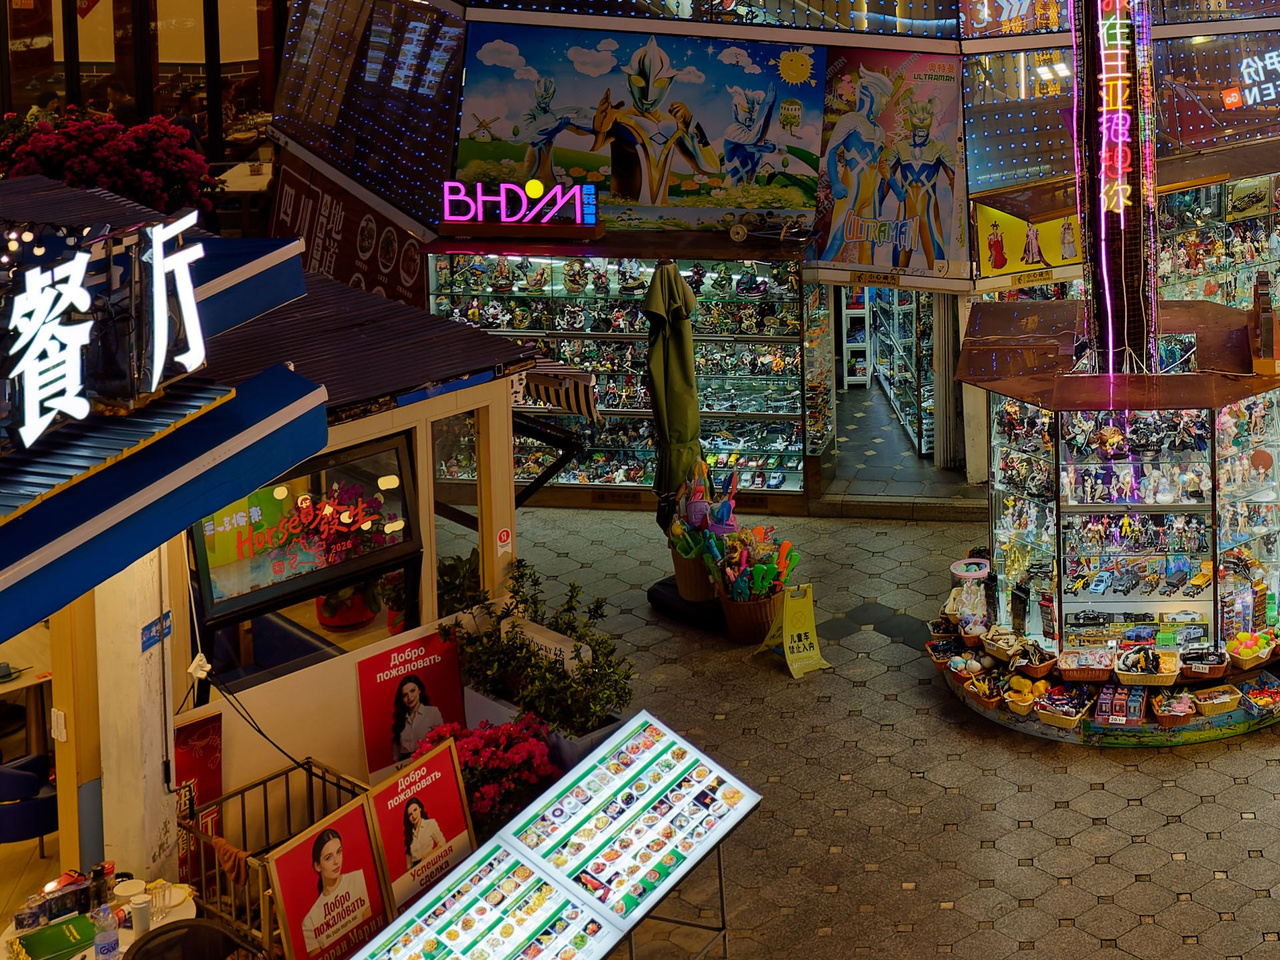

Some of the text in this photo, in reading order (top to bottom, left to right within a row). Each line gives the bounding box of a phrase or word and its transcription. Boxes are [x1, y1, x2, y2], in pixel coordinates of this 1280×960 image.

[913, 73, 956, 83] ULTRAMAN
[843, 210, 920, 253] ULTRAMAN
[8, 209, 208, 449] 餐厅
[235, 515, 303, 561] Horse
[330, 540, 353, 554] 2026
[788, 641, 815, 656] 禁止入内
[789, 631, 810, 645] 儿童车
[376, 652, 442, 684] пожаловать
[390, 645, 426, 668] Добро
[387, 769, 442, 810] пожаловать
[397, 765, 428, 792] Добро
[409, 844, 454, 882] Успешная
[418, 859, 451, 888] сделка
[313, 896, 366, 940] пожаловать
[323, 890, 351, 919] Добро
